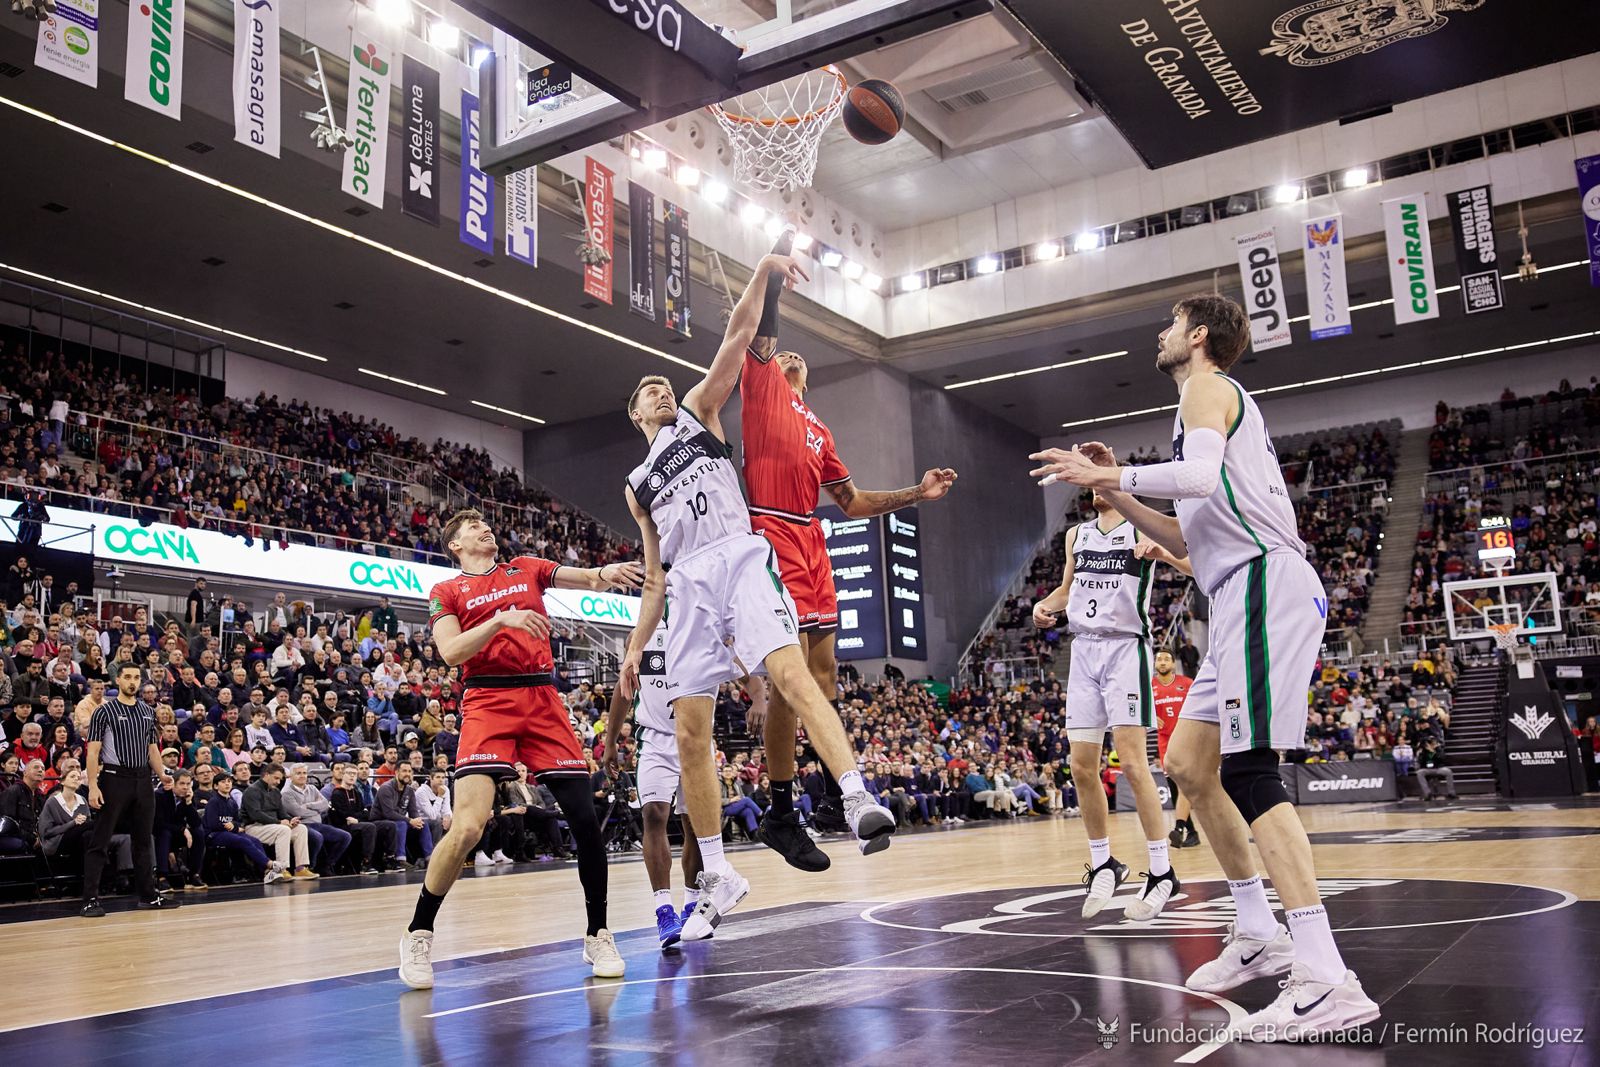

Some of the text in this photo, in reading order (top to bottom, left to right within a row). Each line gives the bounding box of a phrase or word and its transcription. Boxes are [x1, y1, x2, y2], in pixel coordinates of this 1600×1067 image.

[1120, 18, 1159, 47] DE
[247, 18, 265, 145] emasagra
[530, 77, 548, 91] liga
[530, 80, 570, 101] endesa
[352, 76, 380, 195] fertisac
[409, 84, 423, 160] deLuna
[425, 119, 433, 166] HOTELS
[1458, 191, 1477, 250] DE VERDAD
[1471, 187, 1497, 264] BURGERS
[1398, 203, 1429, 314] COVIRAN
[1248, 246, 1280, 332] Jeep
[806, 426, 824, 455] 24
[686, 491, 708, 522] 10
[104, 525, 200, 564] OCAÑA
[1482, 530, 1508, 549] 16
[350, 561, 424, 593] OCAÑA
[466, 584, 528, 610] COVIRAN
[581, 595, 632, 621] OCAÑA
[1086, 599, 1097, 618] 3
[1166, 707, 1174, 717] 5
[1307, 774, 1384, 792] COVIRAN
